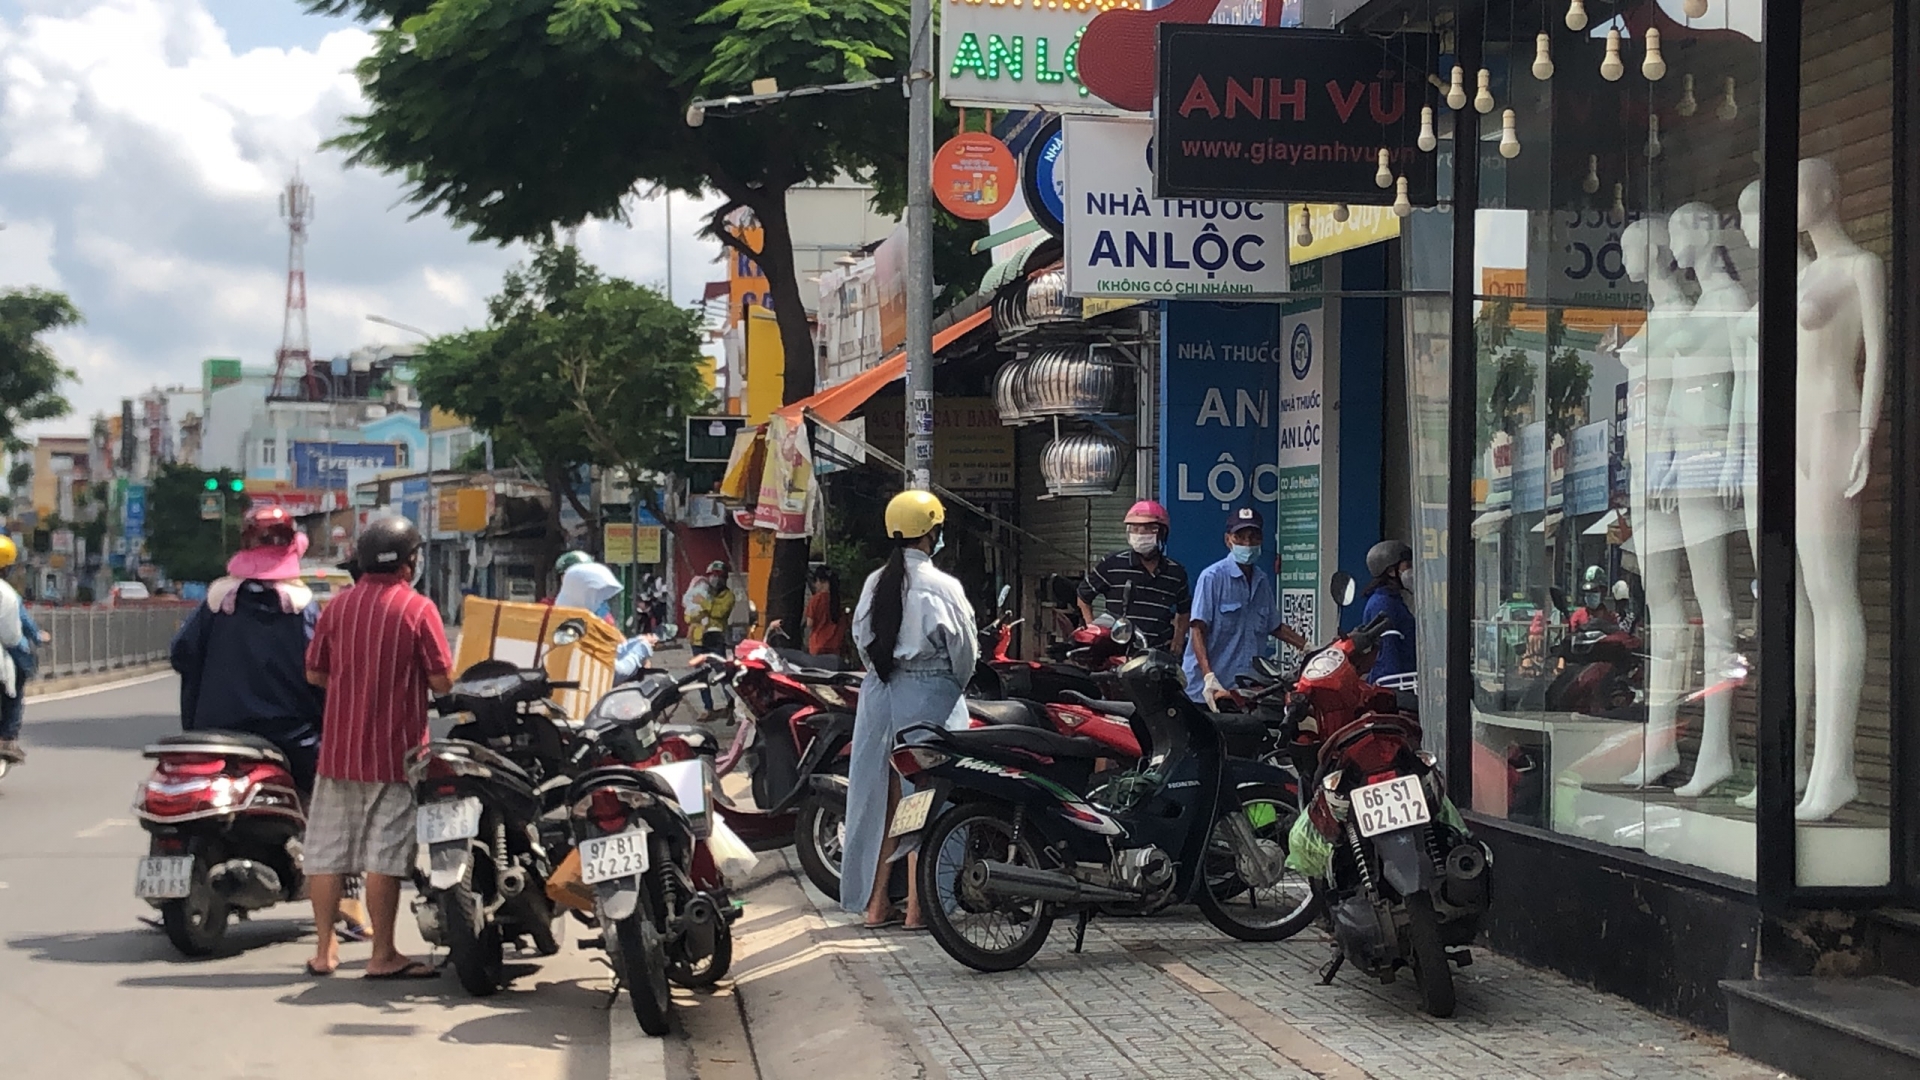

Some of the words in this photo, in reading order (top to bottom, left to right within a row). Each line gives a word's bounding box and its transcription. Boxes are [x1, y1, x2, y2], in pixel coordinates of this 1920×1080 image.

[950, 32, 1024, 82] AN
[1178, 73, 1307, 121] ANH
[1325, 69, 1406, 124] VŨ
[1086, 187, 1151, 216] NHÀ
[1097, 278, 1151, 292] (KHÔNG
[1153, 279, 1173, 293] CÓ
[1178, 340, 1216, 360] NHÀ
[1196, 387, 1269, 428] AN
[1281, 394, 1295, 412] NHÀ
[1296, 389, 1321, 410] THUỐC
[1281, 425, 1296, 450] AN
[1298, 419, 1320, 452] LỘC
[1178, 452, 1279, 511] LỘC
[1167, 780, 1201, 789] HONDA
[1362, 780, 1411, 809] 66-S1
[1362, 800, 1426, 832] 024.12
[590, 836, 634, 859] 97-B1
[586, 852, 643, 880] 342.23
